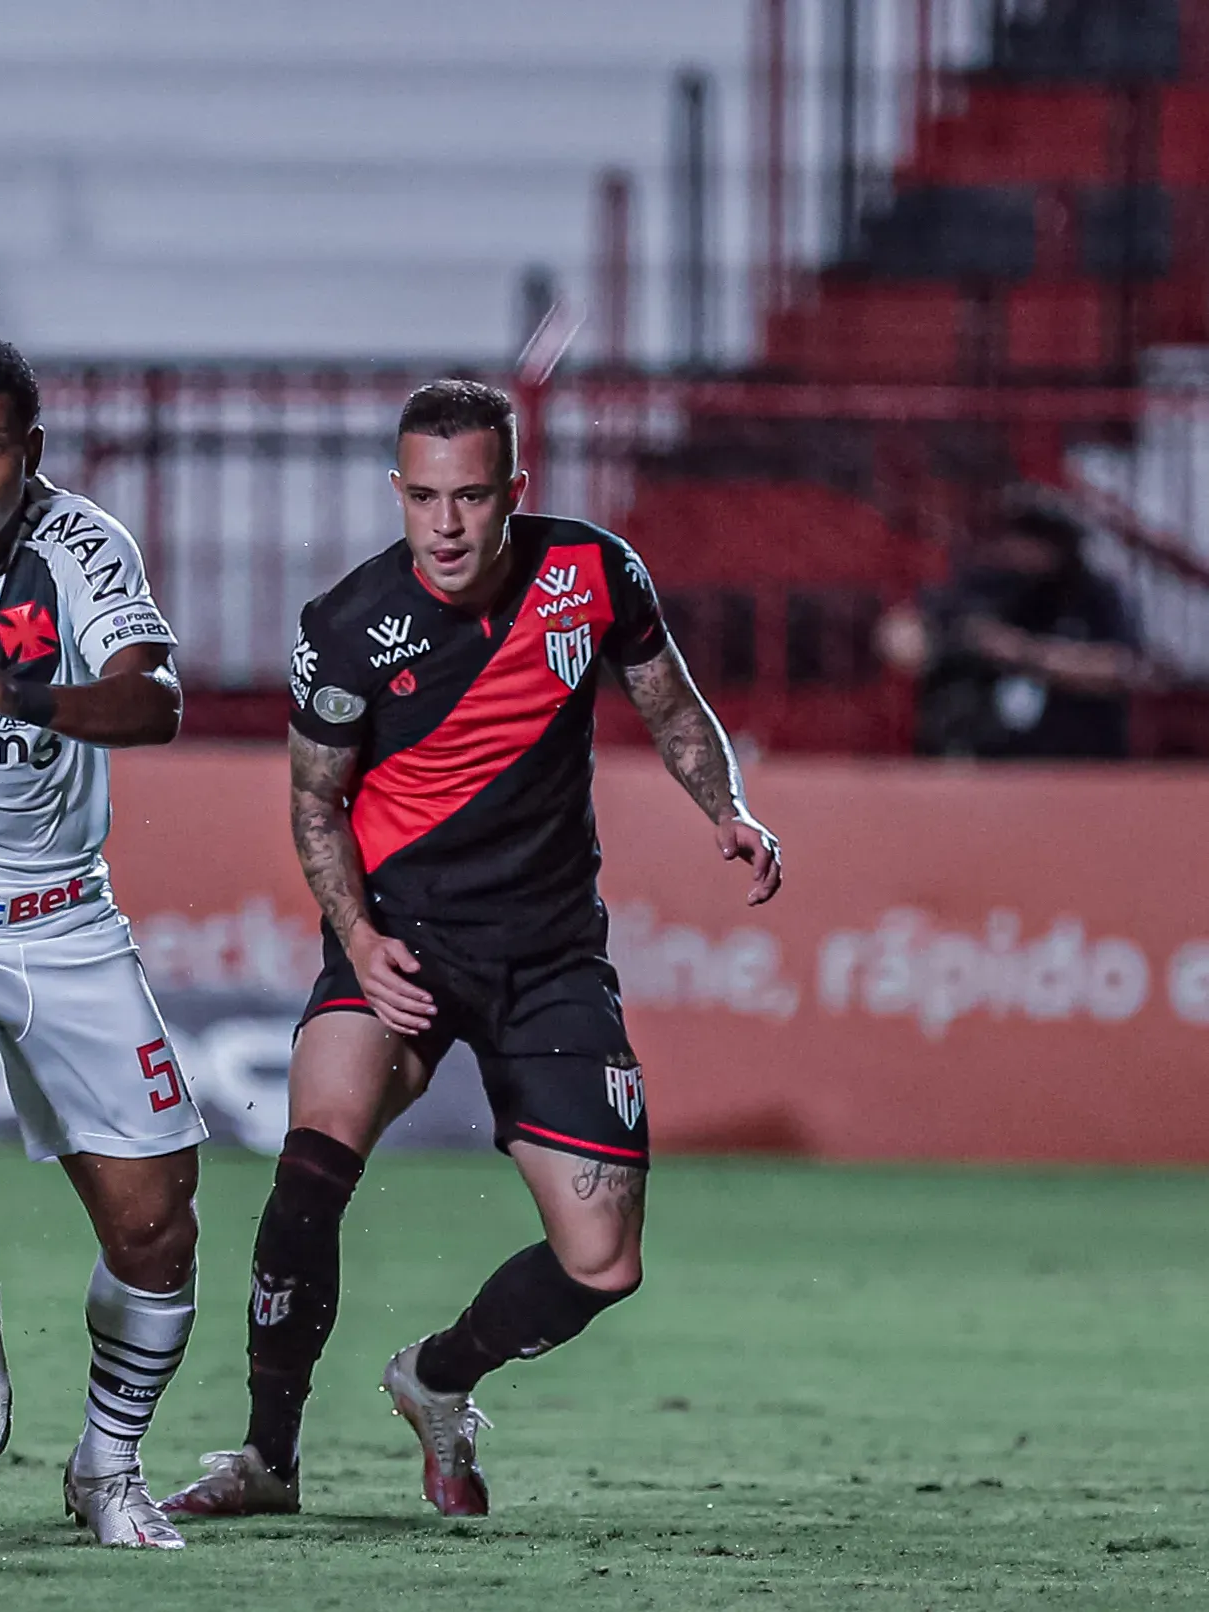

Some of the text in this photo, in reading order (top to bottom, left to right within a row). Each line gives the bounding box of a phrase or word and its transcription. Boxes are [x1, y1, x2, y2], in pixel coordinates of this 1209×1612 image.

[537, 589, 593, 618] WAM
[369, 638, 431, 669] WAM
[135, 1036, 182, 1114] 5
